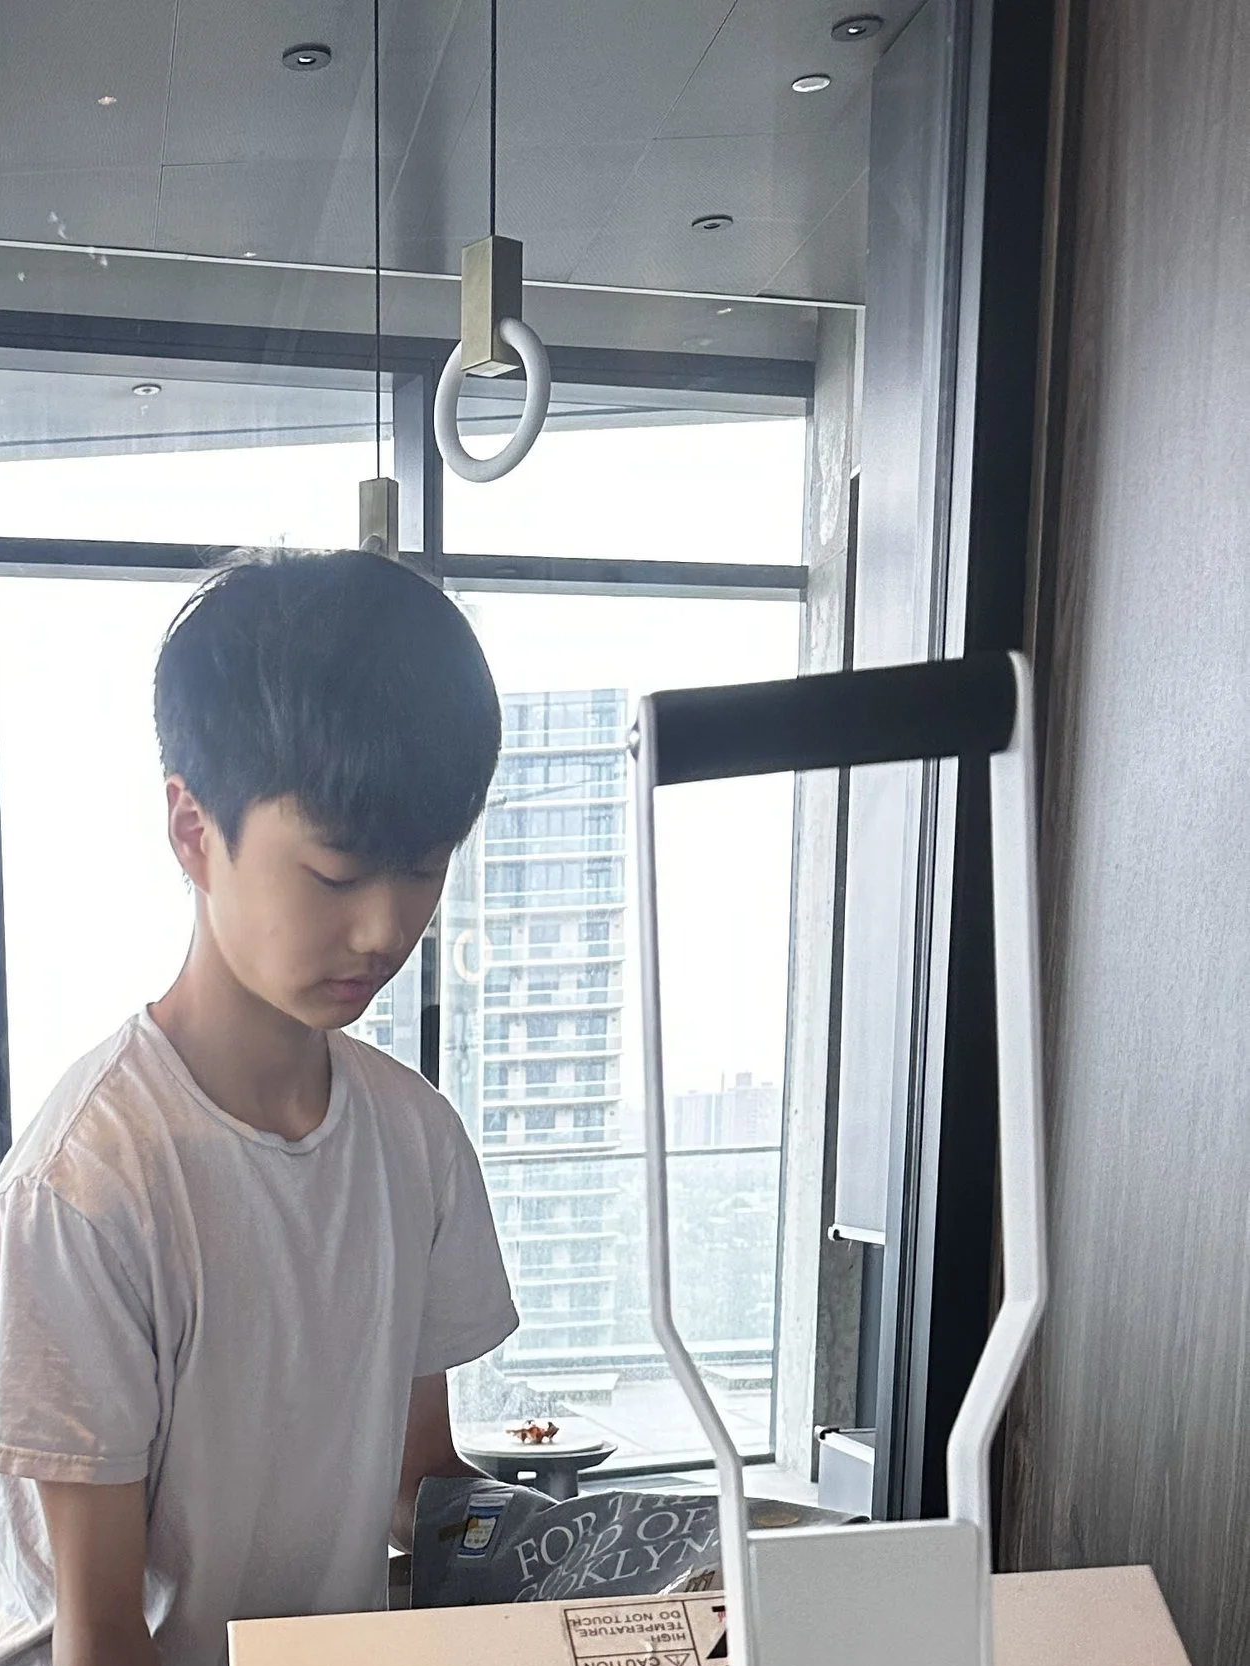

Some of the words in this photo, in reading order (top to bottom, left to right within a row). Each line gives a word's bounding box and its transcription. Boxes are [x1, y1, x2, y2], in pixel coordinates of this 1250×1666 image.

[636, 1506, 713, 1541] OF
[514, 1511, 598, 1582] FOR
[625, 1612, 653, 1622] NOT
[659, 1610, 682, 1620] DO
[651, 1632, 686, 1643] HIGH
